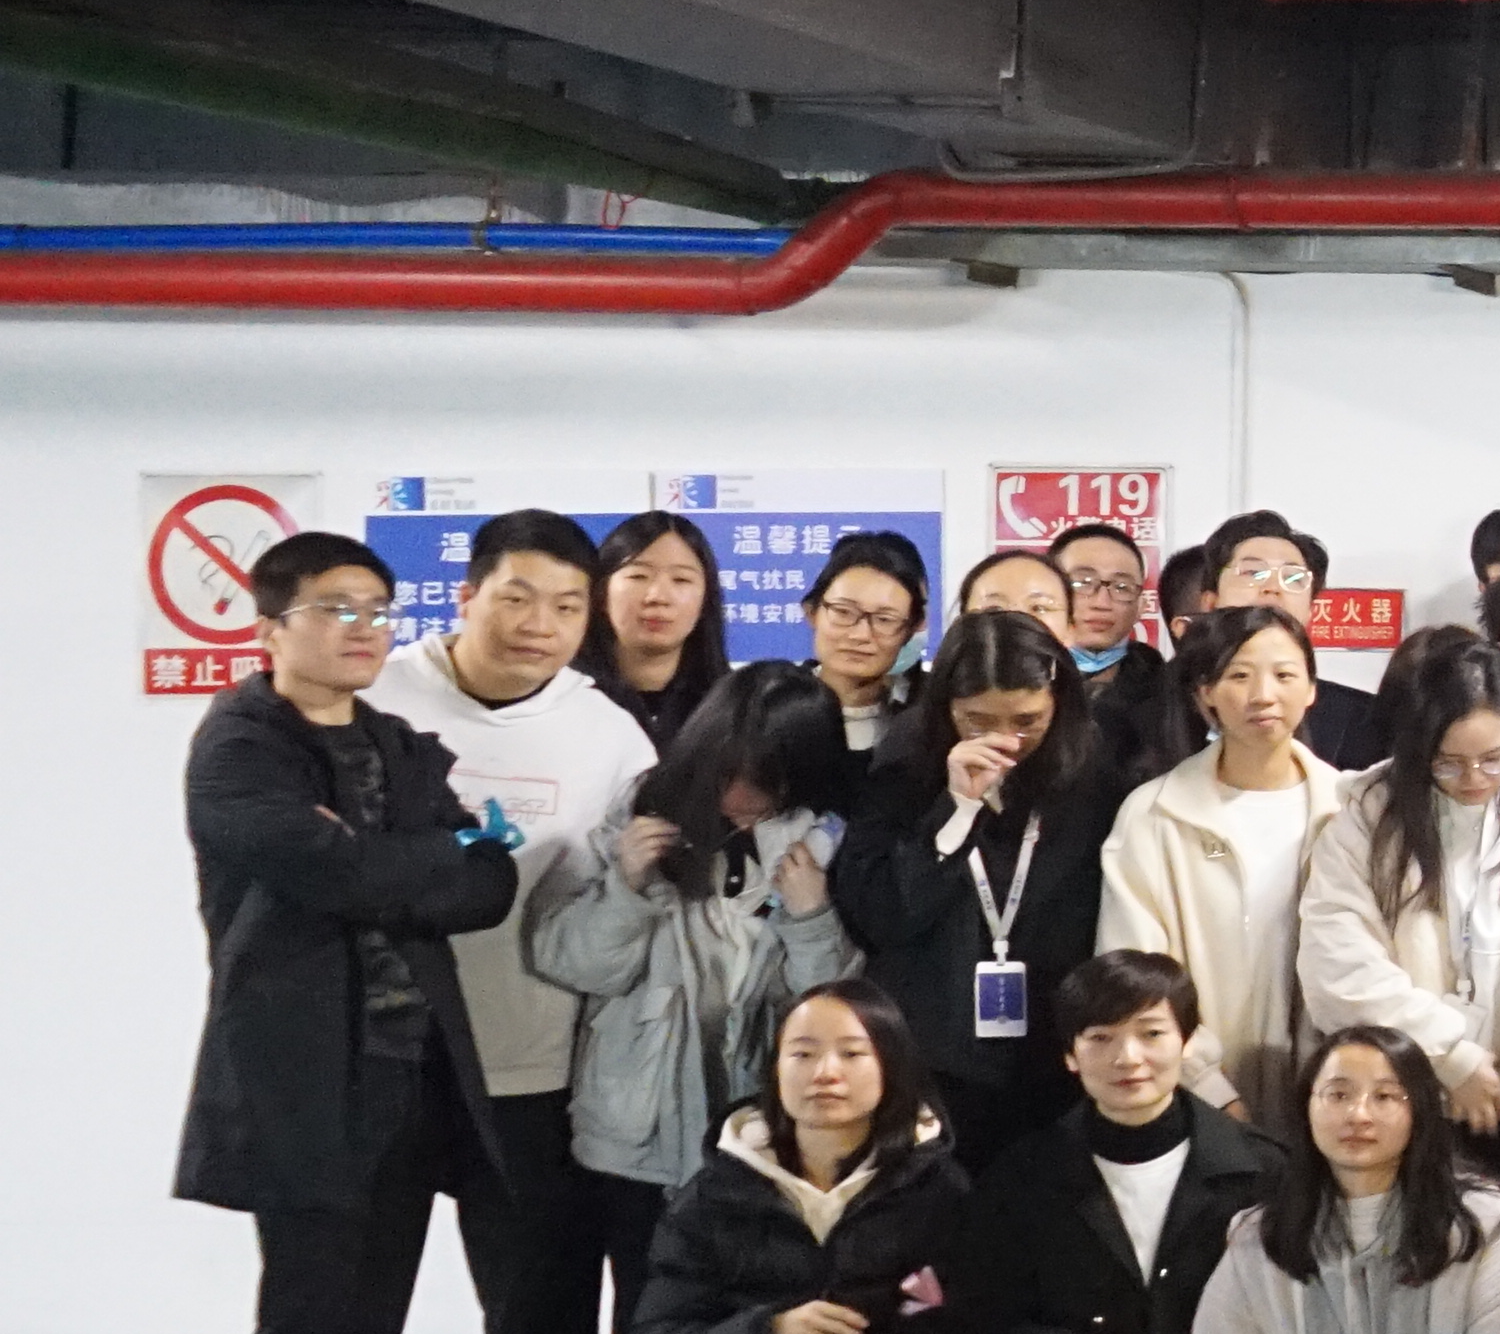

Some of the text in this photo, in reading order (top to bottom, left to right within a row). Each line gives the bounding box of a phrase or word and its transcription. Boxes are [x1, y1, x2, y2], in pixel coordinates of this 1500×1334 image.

[1058, 473, 1150, 516] 119
[1313, 597, 1392, 623] 灭火器
